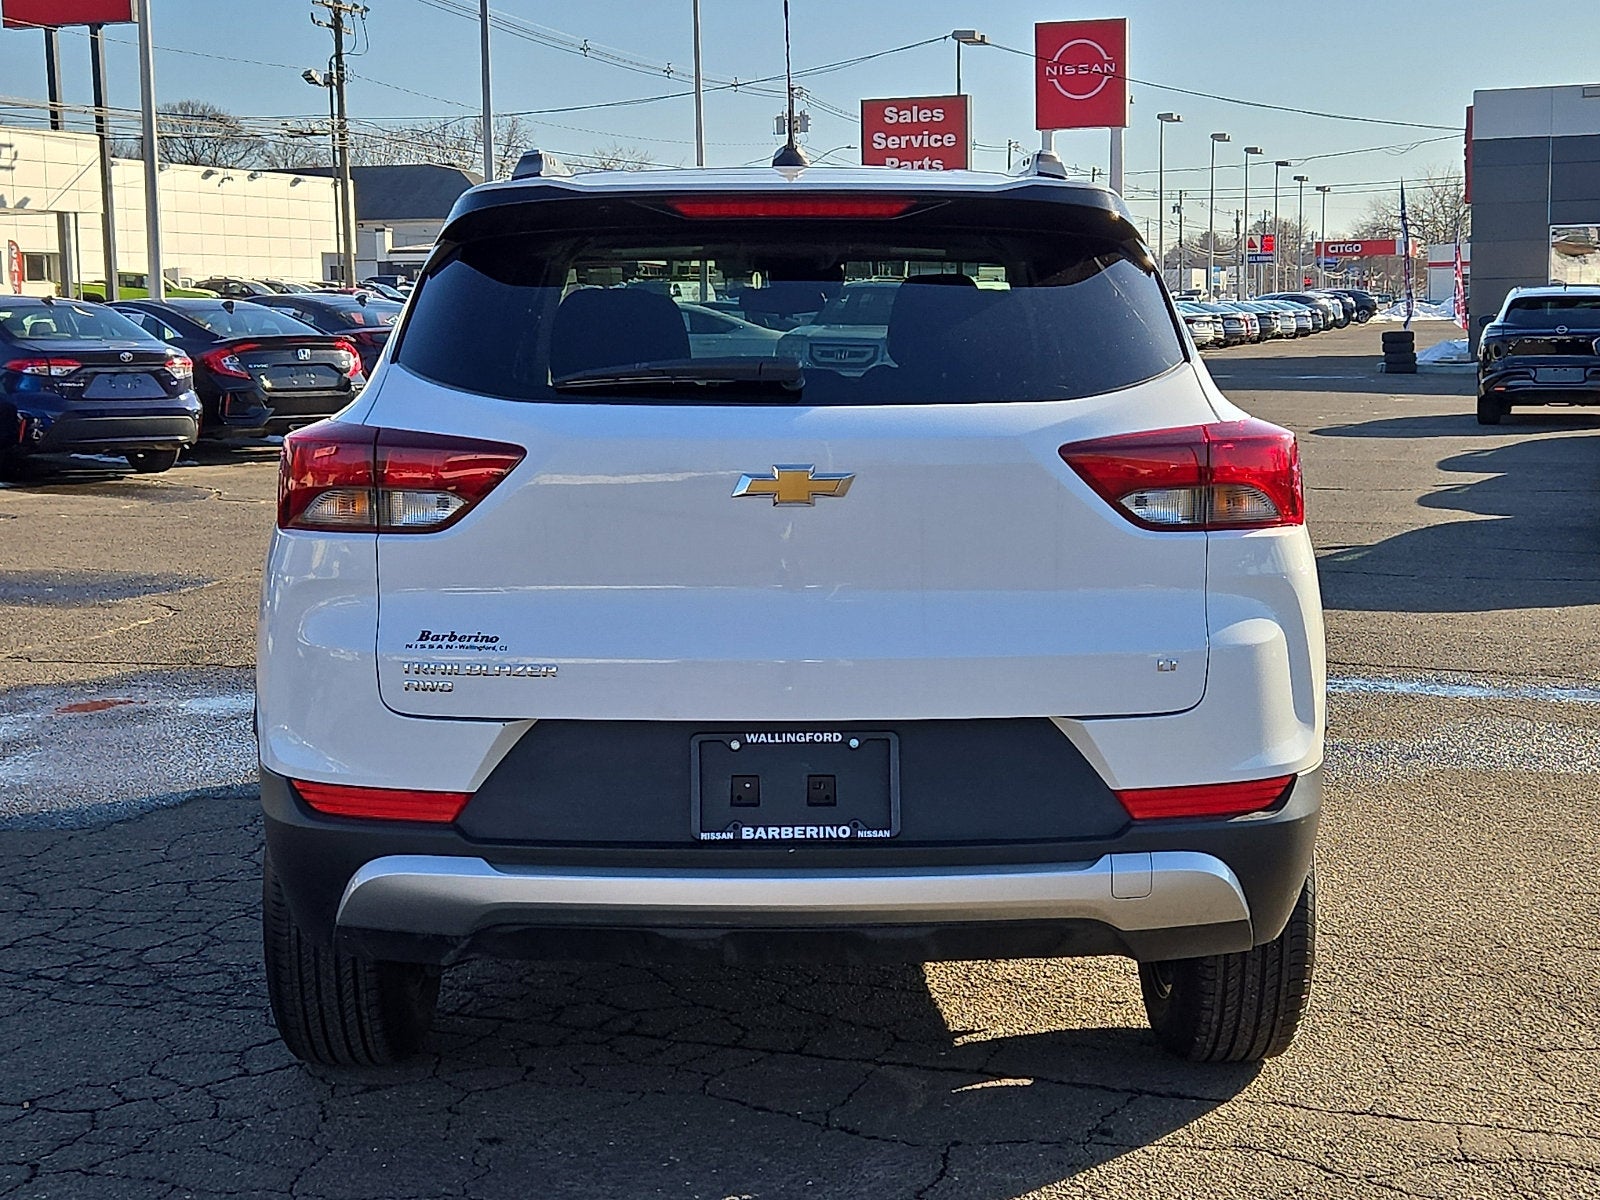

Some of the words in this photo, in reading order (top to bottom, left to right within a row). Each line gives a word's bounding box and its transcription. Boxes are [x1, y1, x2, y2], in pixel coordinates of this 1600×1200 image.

[1045, 62, 1116, 77] NISSAN
[884, 106, 945, 124] Sales
[872, 131, 957, 150] Service
[885, 156, 944, 171] Parts
[1328, 243, 1362, 254] CITGO
[416, 630, 500, 643] Barberino
[402, 661, 558, 677] TRAILBLAZER
[403, 680, 454, 693] AWD
[745, 733, 843, 743] WALLINGFORD
[700, 831, 734, 840] NISSAN
[741, 826, 851, 839] BARBERINO
[857, 829, 891, 838] NISSAN
